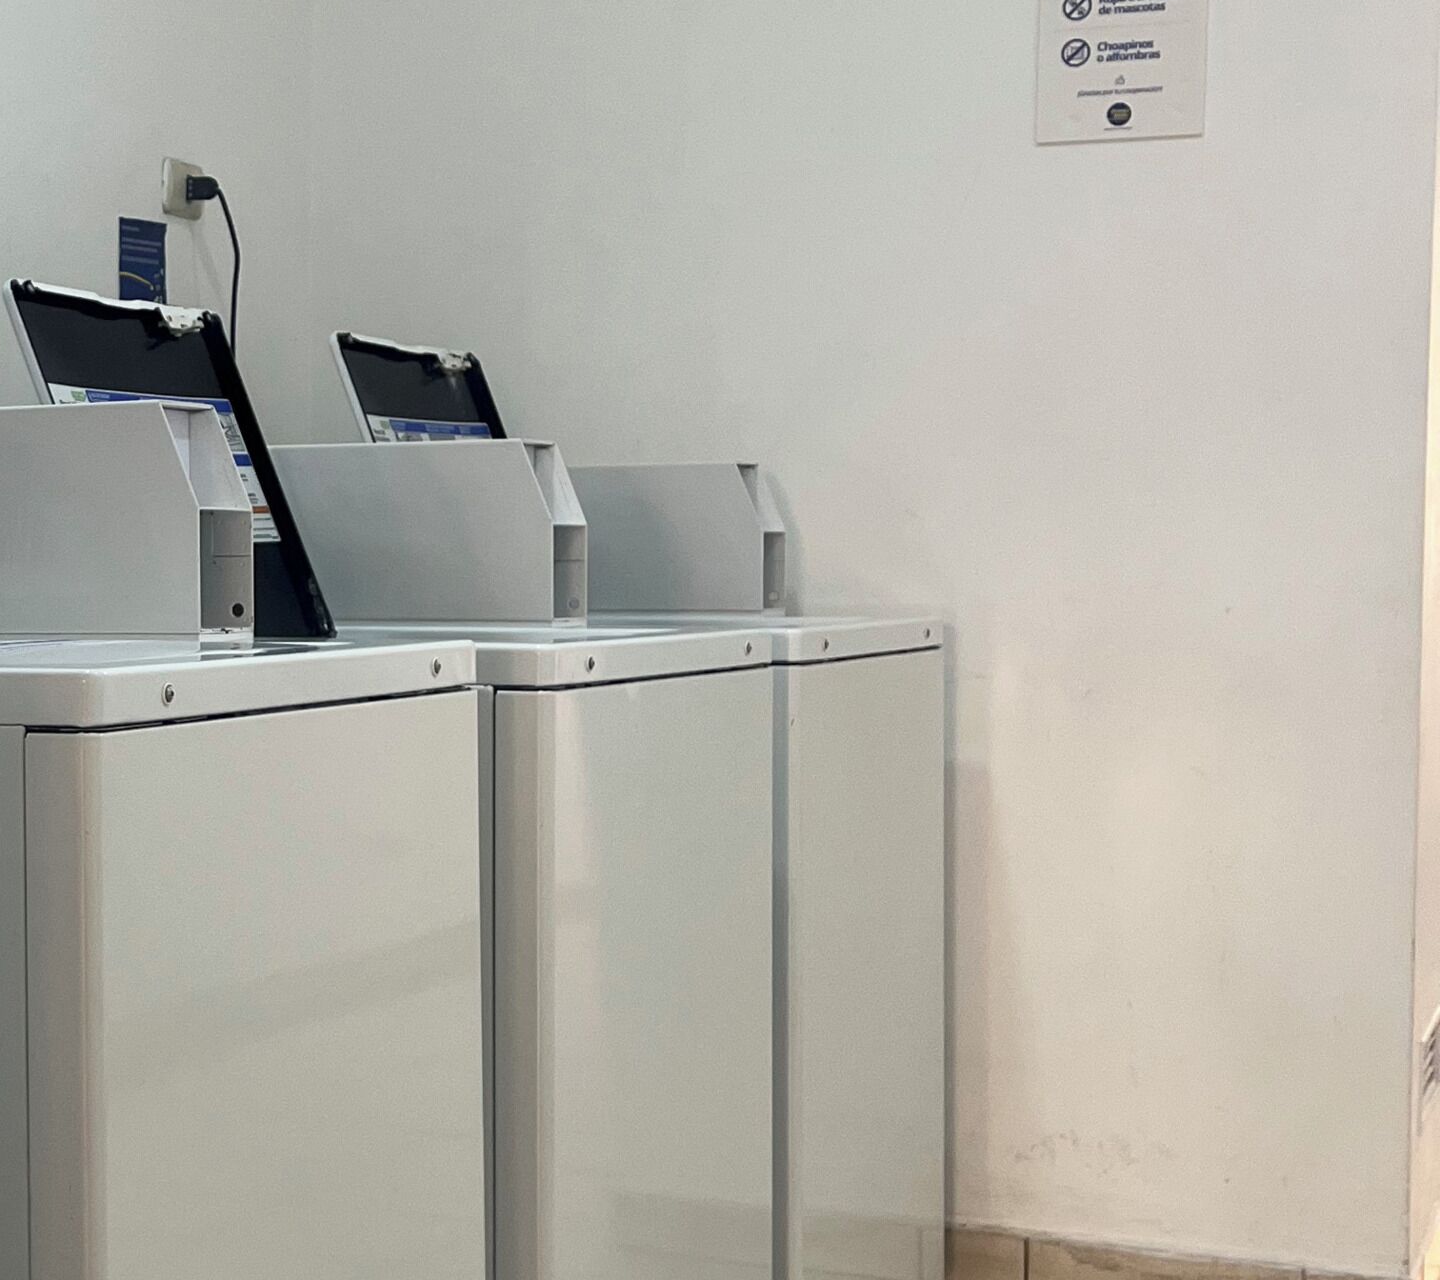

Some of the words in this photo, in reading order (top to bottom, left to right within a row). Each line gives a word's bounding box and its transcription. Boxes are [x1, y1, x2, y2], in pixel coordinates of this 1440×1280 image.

[1098, 5, 1112, 15] de
[1114, 2, 1166, 14] mascotas
[1097, 54, 1104, 62] o
[1106, 50, 1161, 62] alfombras
